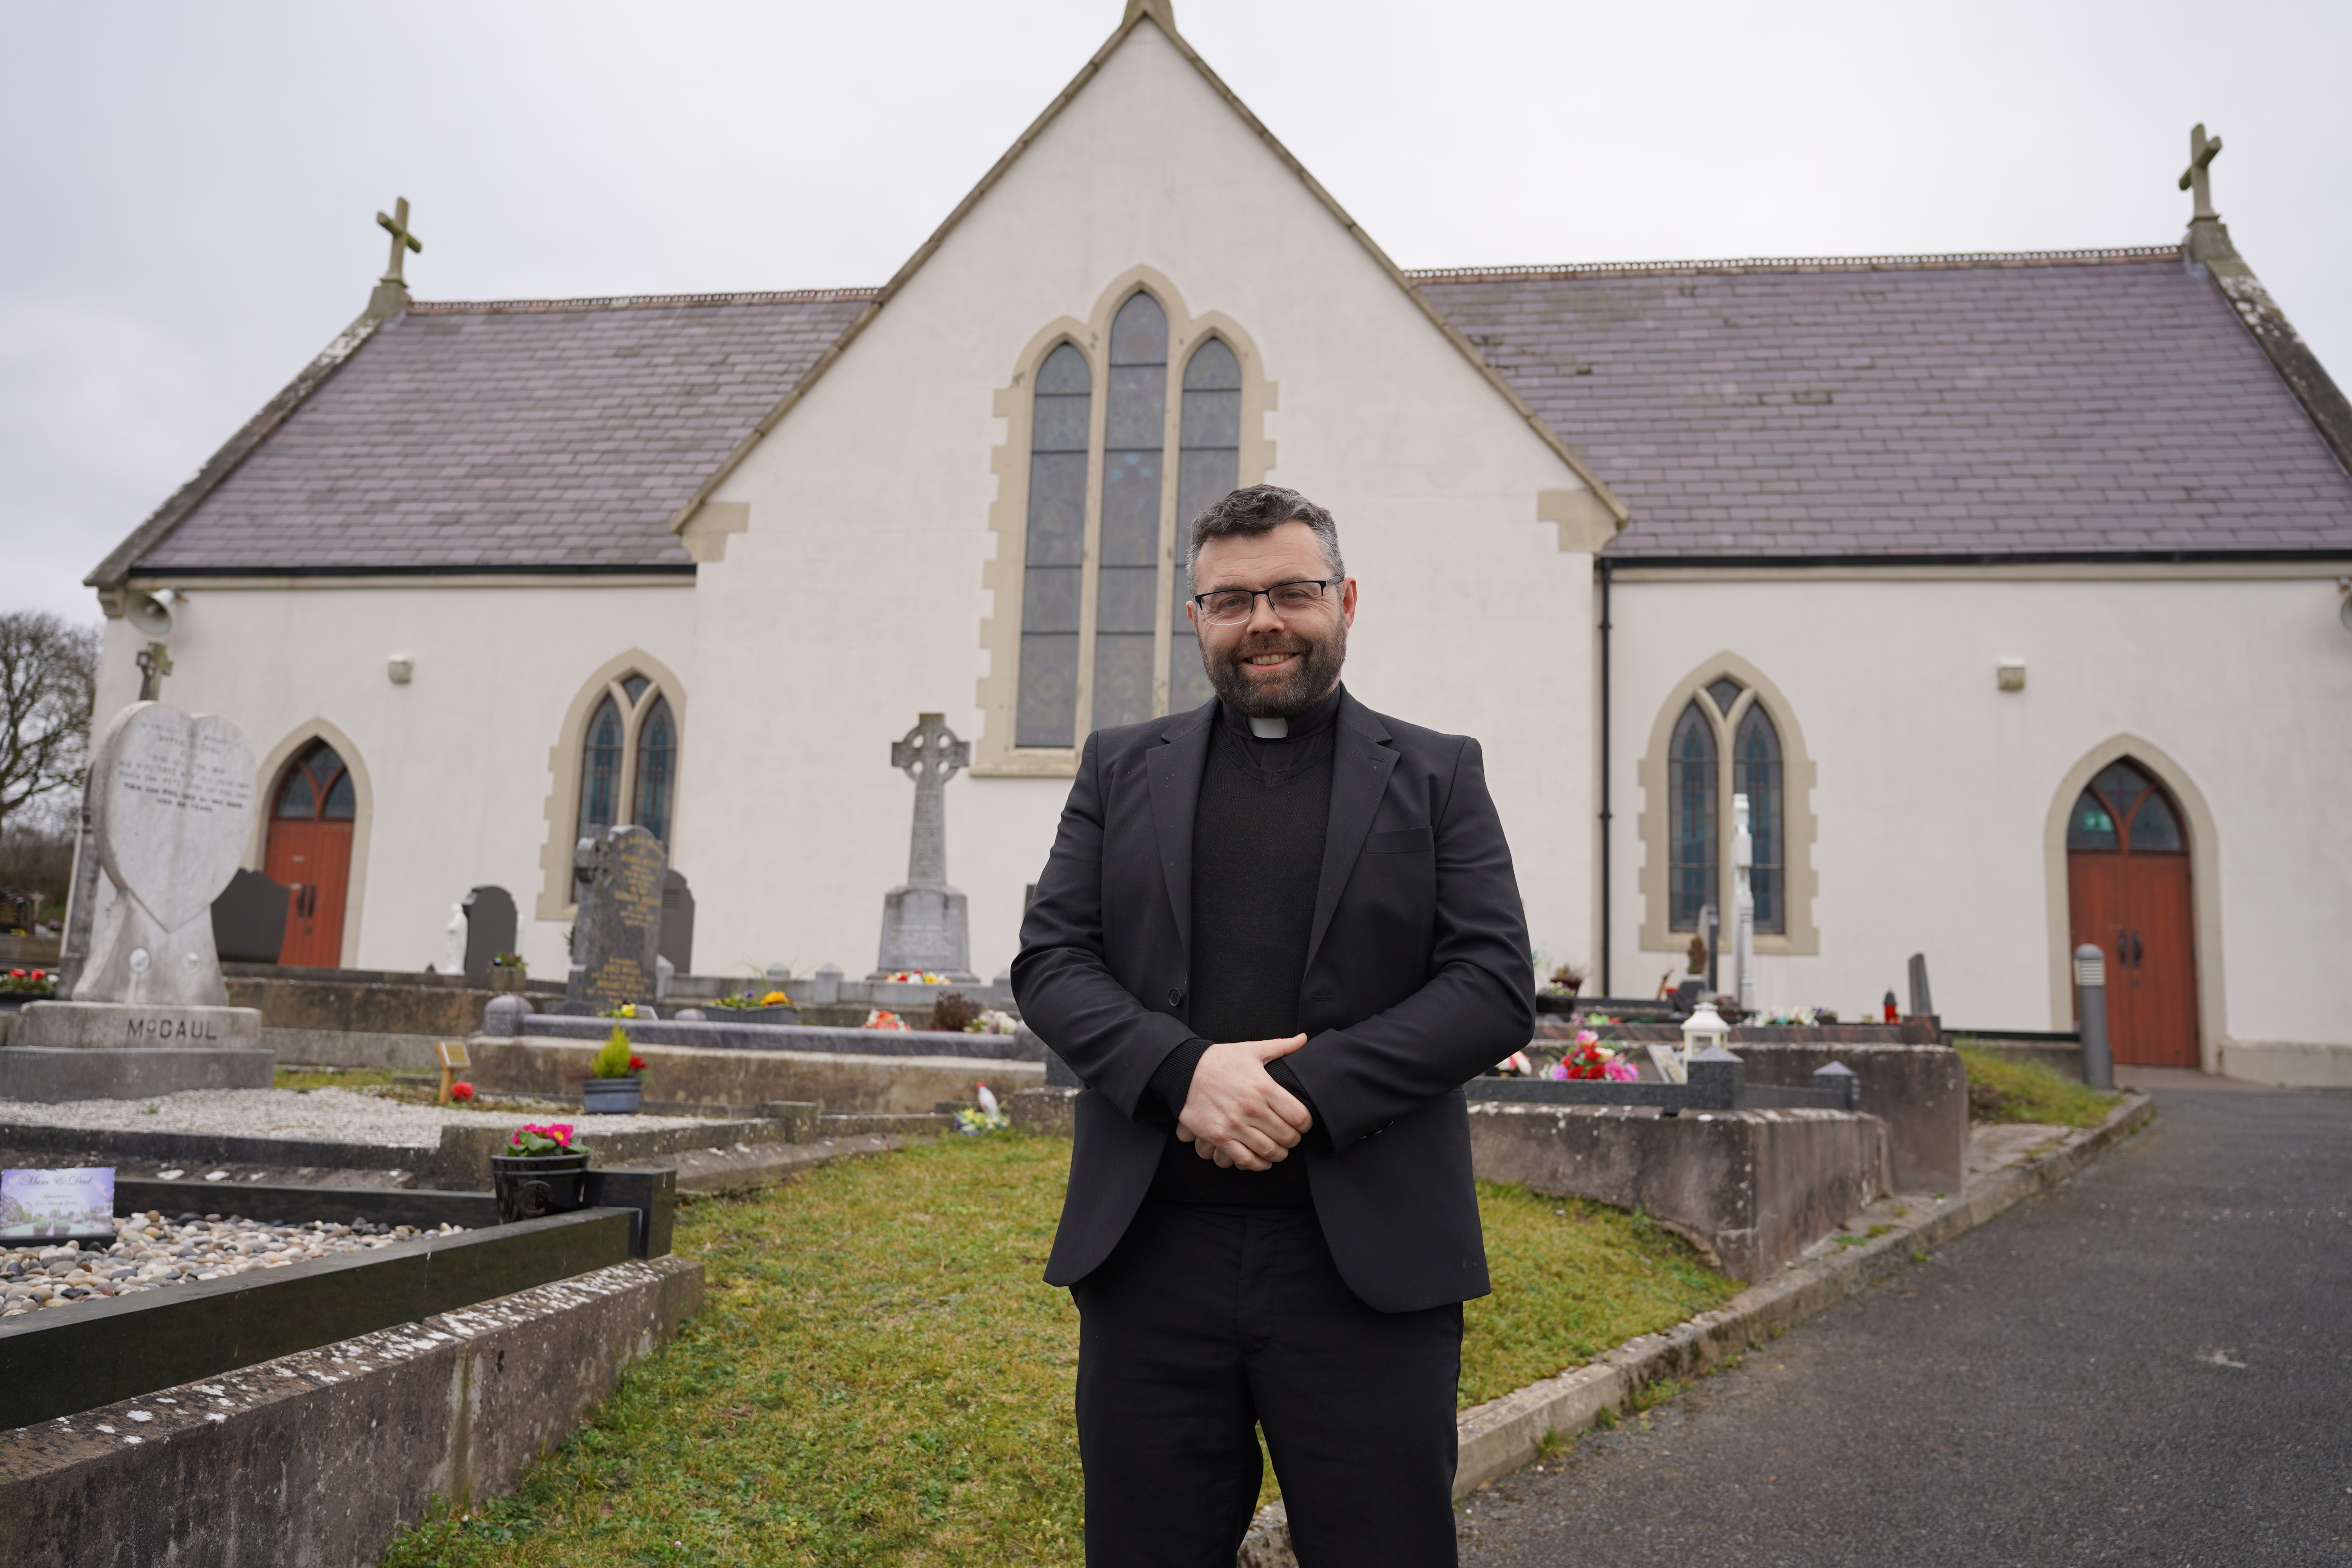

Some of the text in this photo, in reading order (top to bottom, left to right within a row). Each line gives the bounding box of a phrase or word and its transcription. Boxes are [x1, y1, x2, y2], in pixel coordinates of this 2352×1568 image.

[21, 1174, 94, 1186] Mum & Dad
